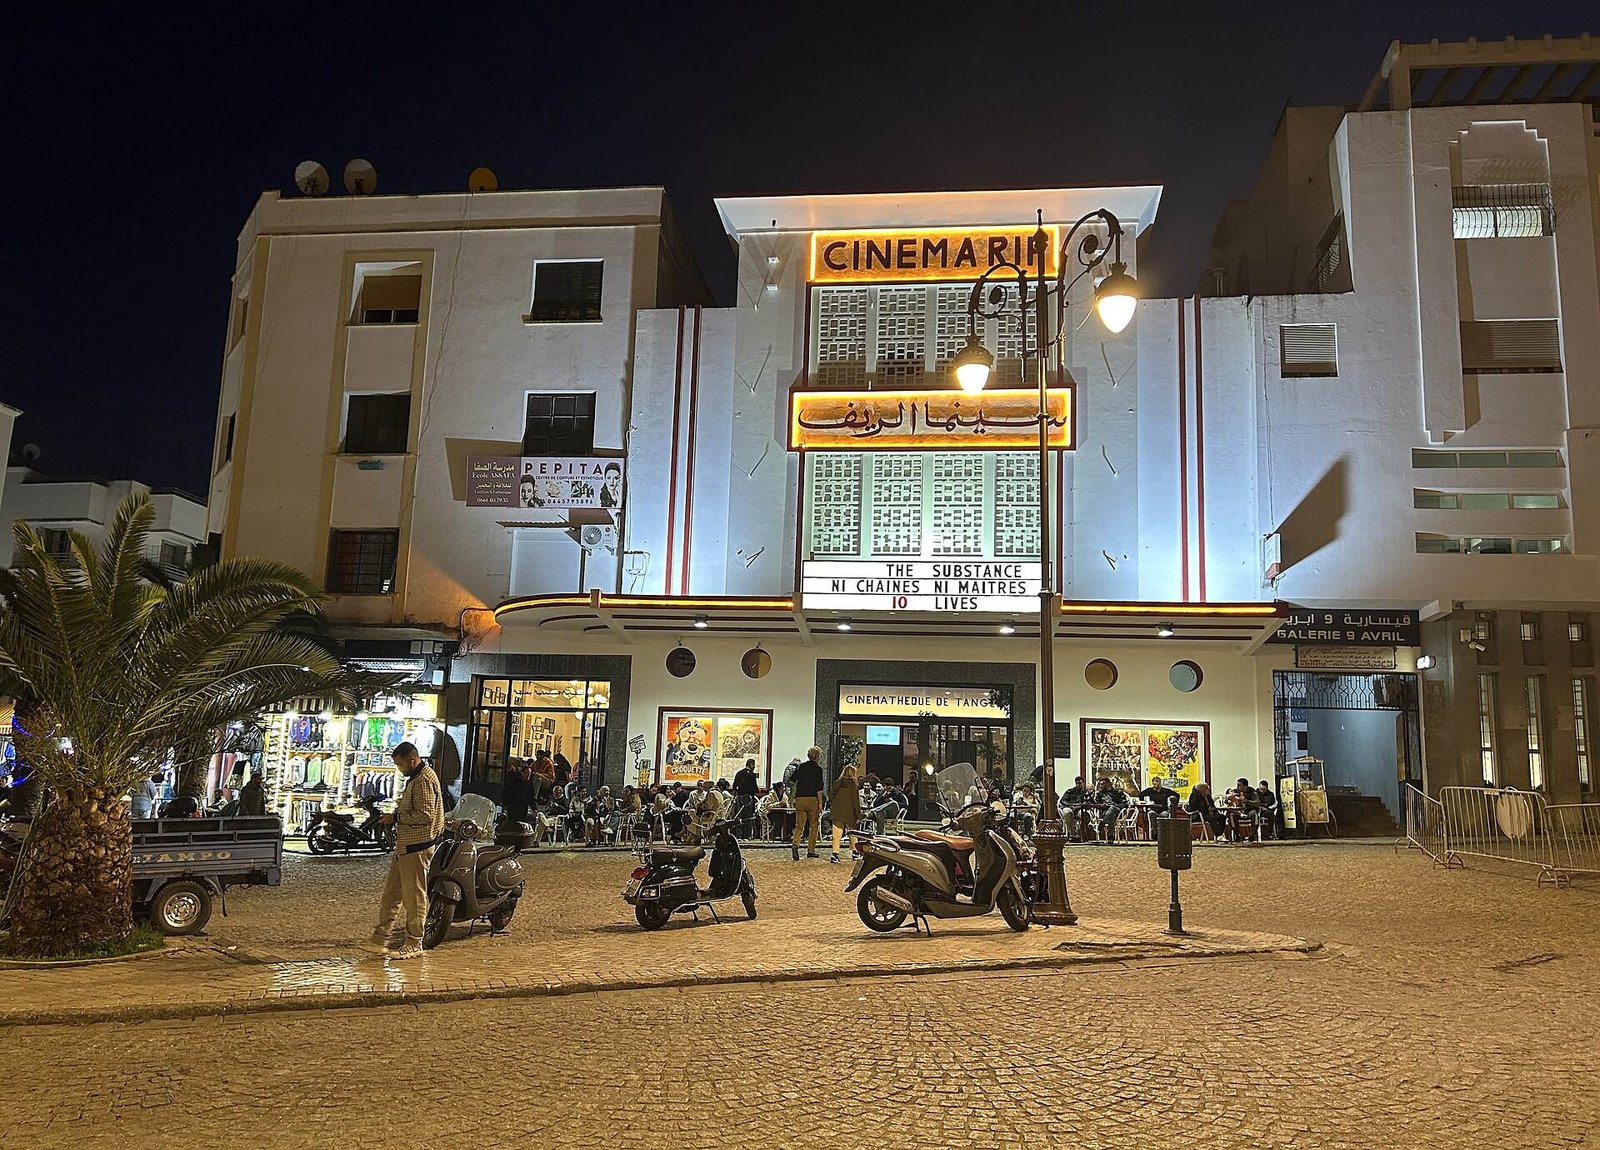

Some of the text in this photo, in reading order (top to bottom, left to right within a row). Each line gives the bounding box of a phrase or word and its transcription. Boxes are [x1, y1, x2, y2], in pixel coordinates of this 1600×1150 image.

[798, 401, 1067, 438] سينما الريف
[524, 462, 603, 475] PEPITA
[886, 563, 1022, 579] THE SUBSTANCE
[831, 579, 1026, 595] NI CHAINES NI MAITRES
[892, 596, 978, 610] 10 LIVES
[1285, 613, 1411, 628] قيسارية 9 ابري
[1277, 629, 1405, 641] GALERIE 9 AVRIL
[845, 694, 996, 708] CINEMATHEQUE DE TANG
